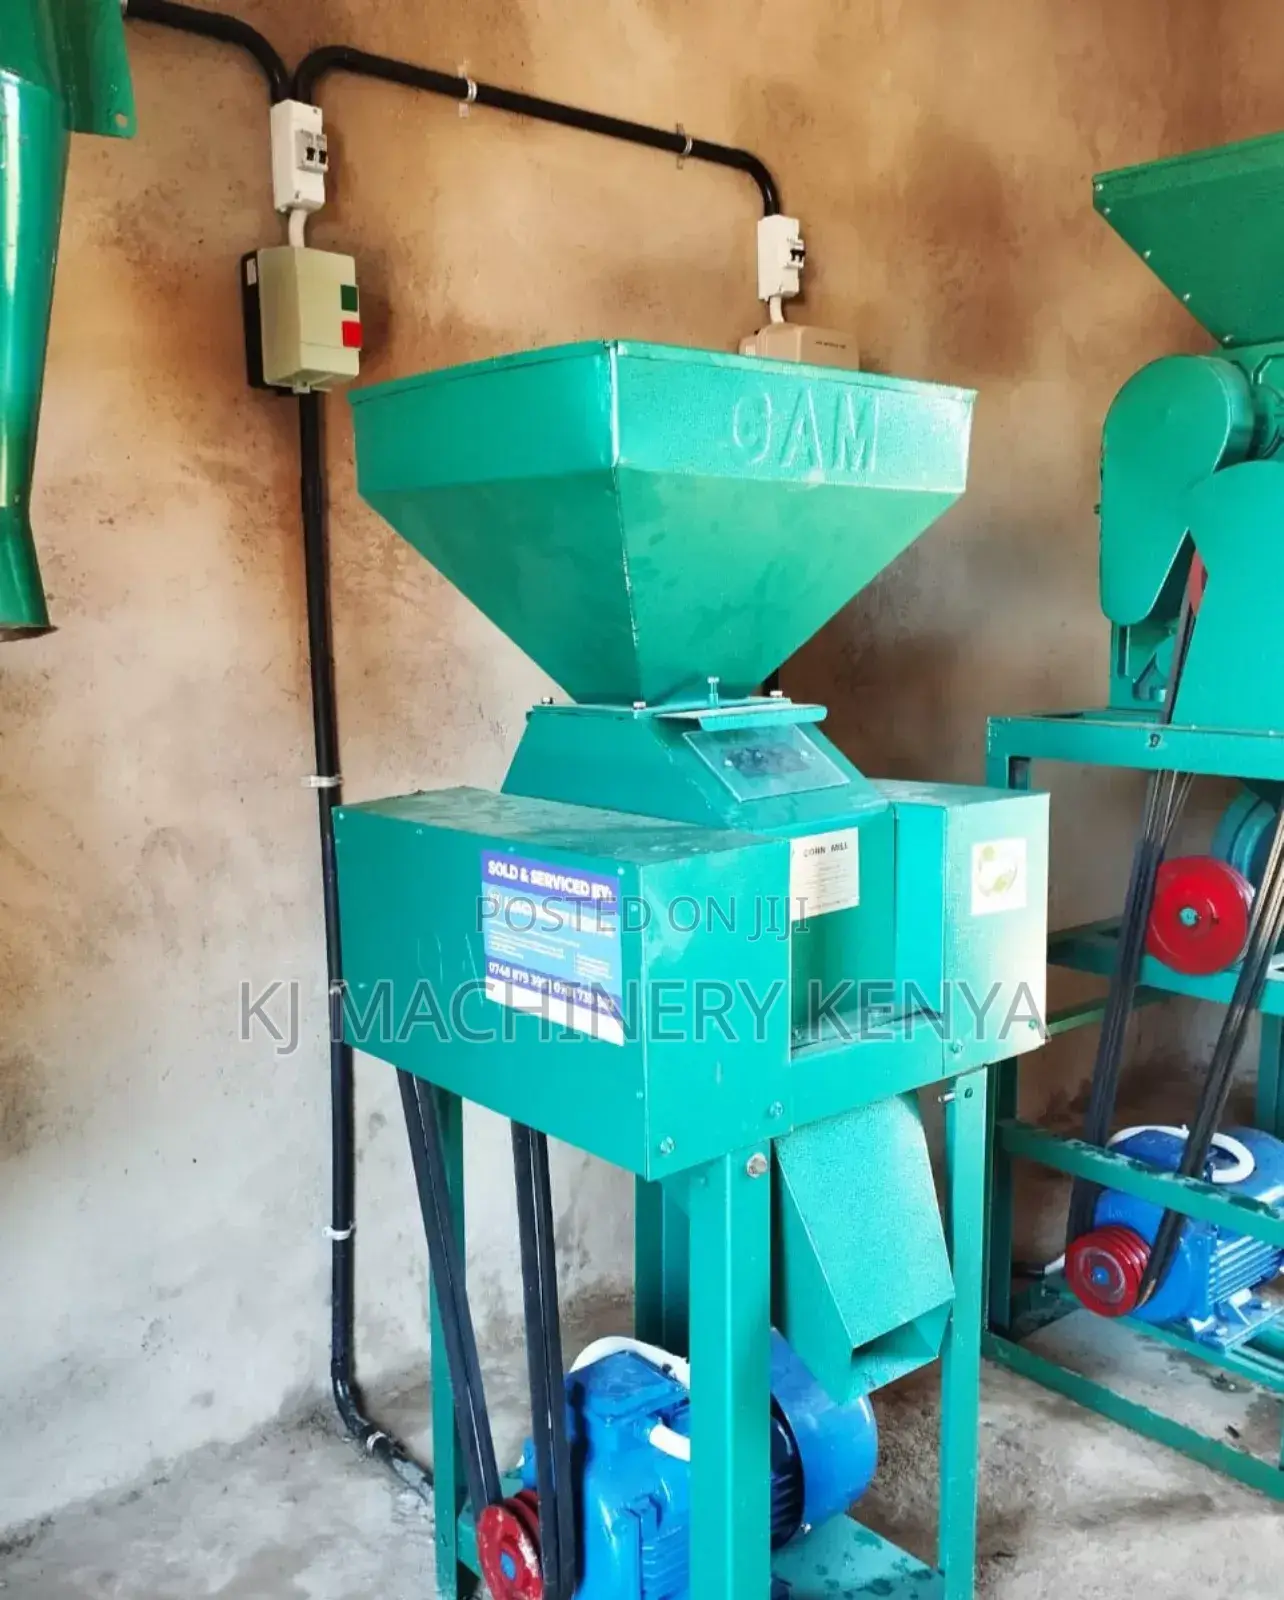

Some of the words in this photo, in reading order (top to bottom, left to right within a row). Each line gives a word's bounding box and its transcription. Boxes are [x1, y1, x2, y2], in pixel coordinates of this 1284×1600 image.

[487, 859, 519, 881] SOLD
[520, 866, 530, 884] &
[530, 869, 590, 897] SERVICED
